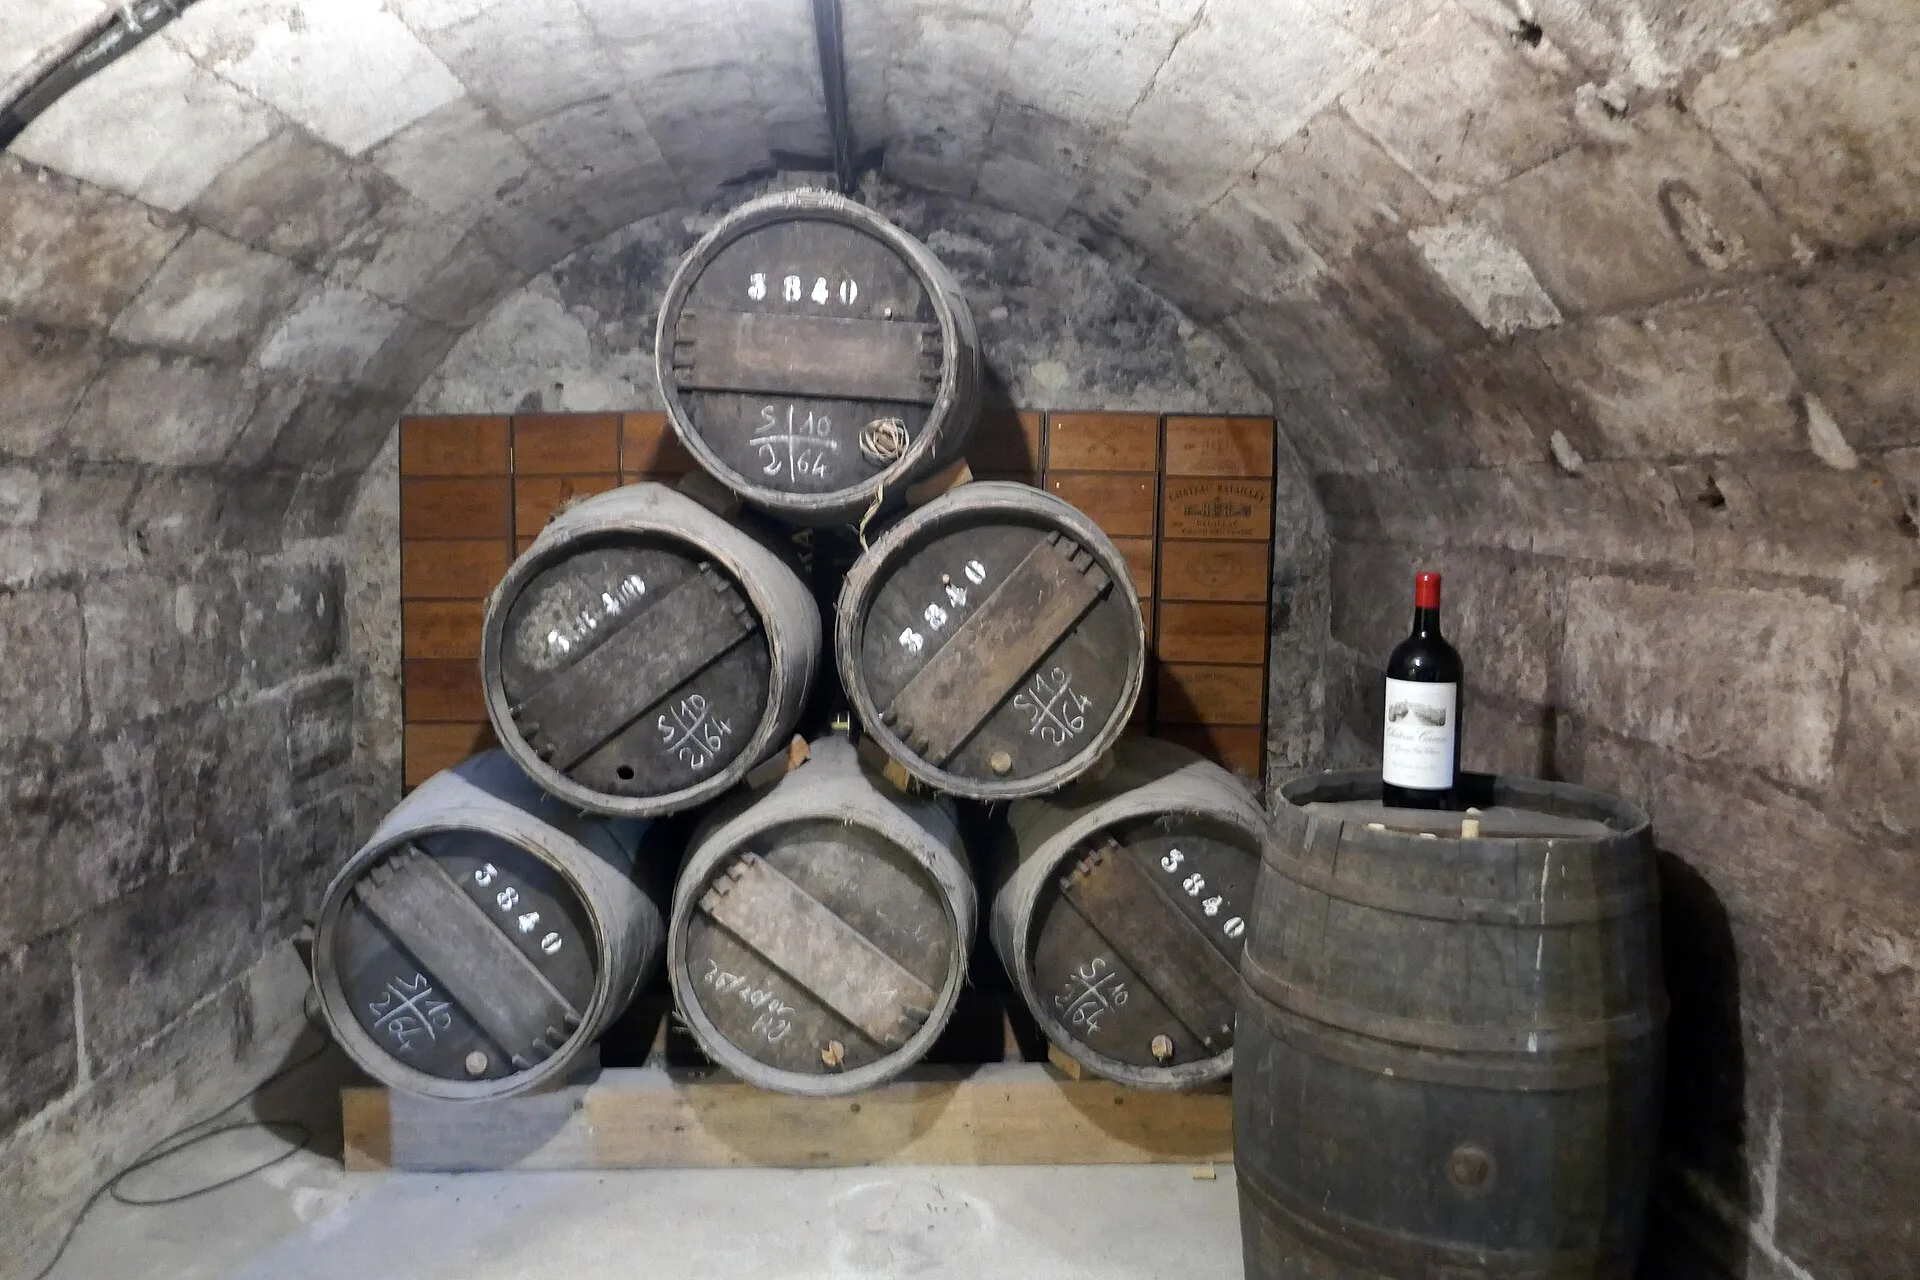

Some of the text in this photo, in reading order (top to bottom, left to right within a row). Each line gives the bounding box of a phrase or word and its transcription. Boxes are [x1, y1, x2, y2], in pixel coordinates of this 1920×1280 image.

[800, 410, 832, 437] 10
[758, 442, 827, 478] 2 64
[1036, 667, 1067, 694] 10
[681, 694, 706, 723] 10
[1041, 688, 1093, 747] 2 64
[679, 716, 732, 770] 2 64
[1111, 983, 1129, 1006] 10
[388, 1016, 423, 1052] 64
[1072, 1001, 1105, 1036] 64
